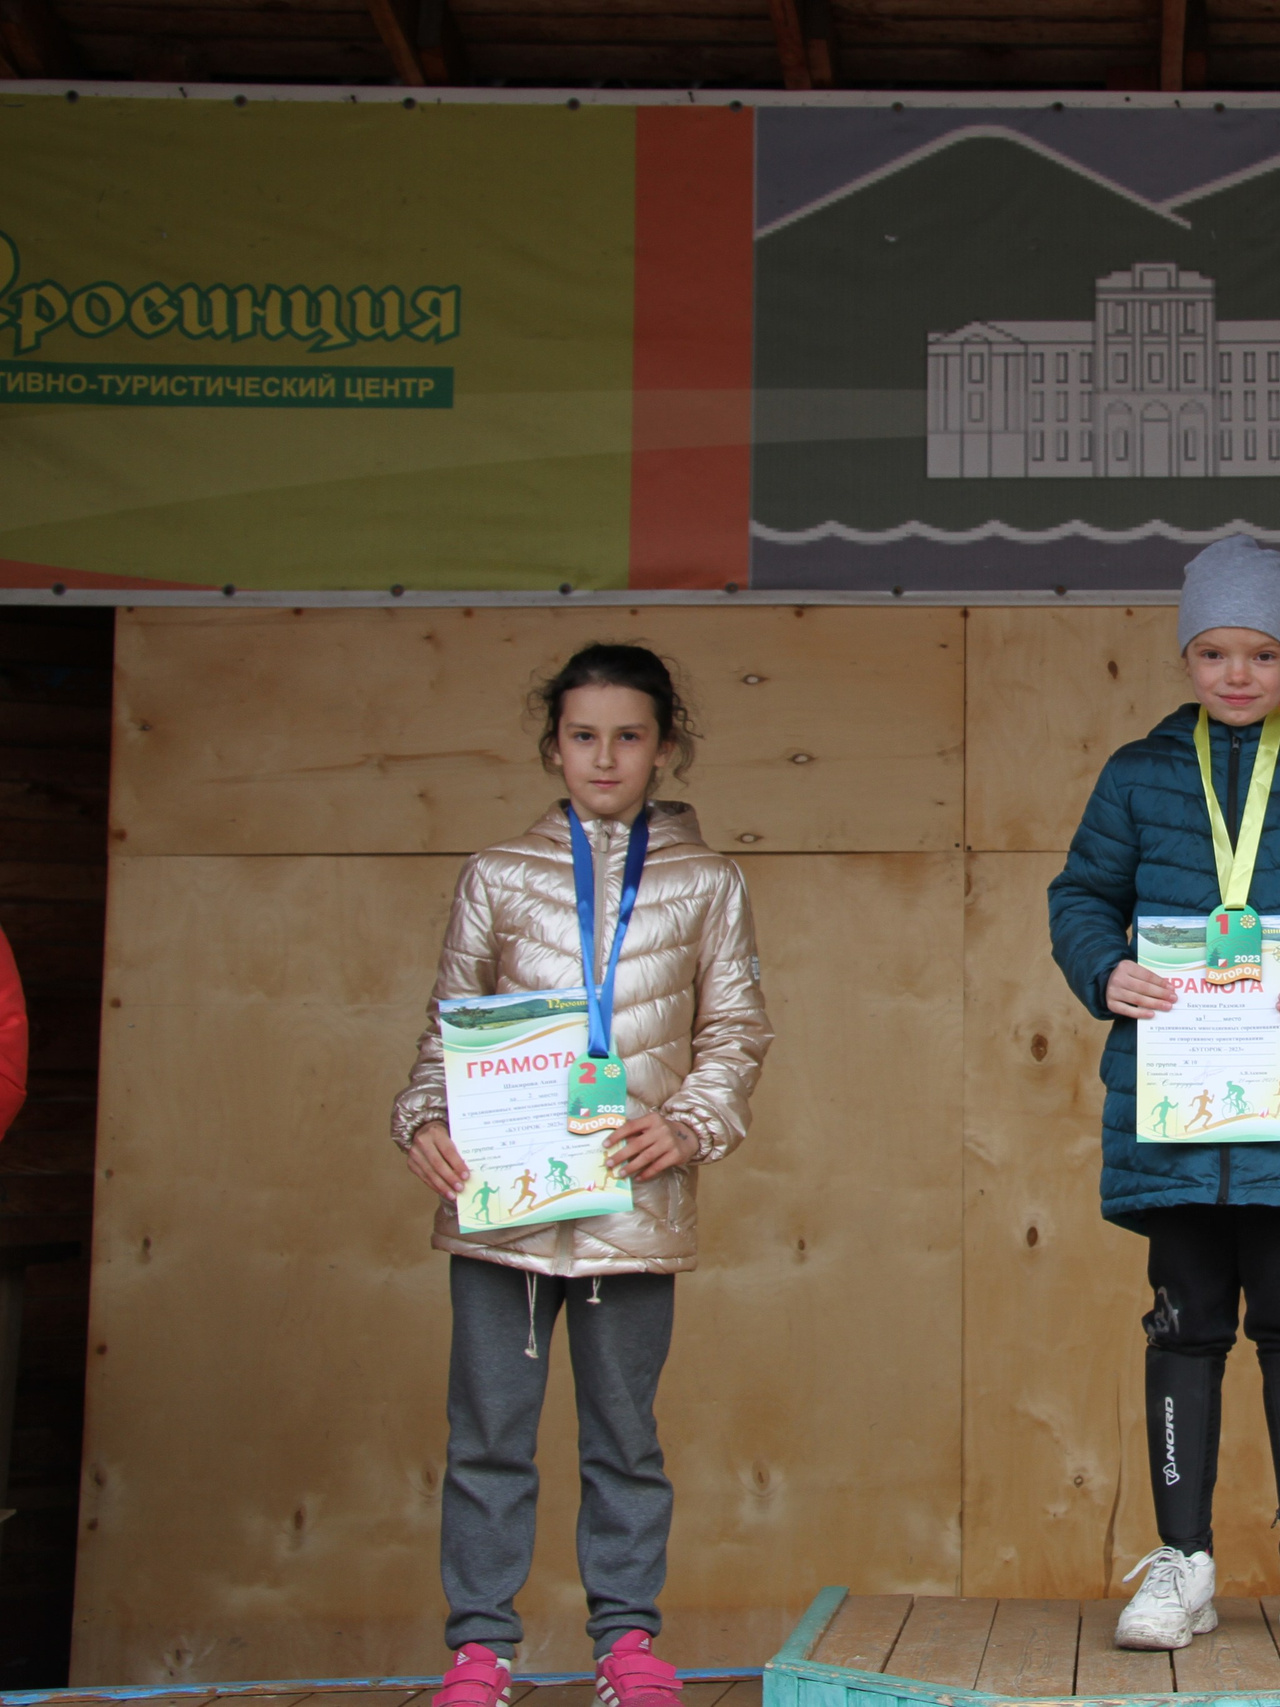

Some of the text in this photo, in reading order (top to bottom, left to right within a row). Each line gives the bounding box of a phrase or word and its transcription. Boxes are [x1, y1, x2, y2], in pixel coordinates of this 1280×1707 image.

[0, 371, 436, 402] ИВНО-ТУРИСТИЧЕСКИЙ ЦЕНТР
[1215, 913, 1229, 935] 1
[1234, 954, 1261, 963] 2023
[1208, 966, 1261, 981] БУГОРОК
[466, 1050, 577, 1079] ГРАМОТА
[578, 1062, 597, 1084] 2
[597, 1104, 625, 1114] 2023
[569, 1116, 626, 1131] БУГОРОК
[1164, 1396, 1176, 1462] NORD
